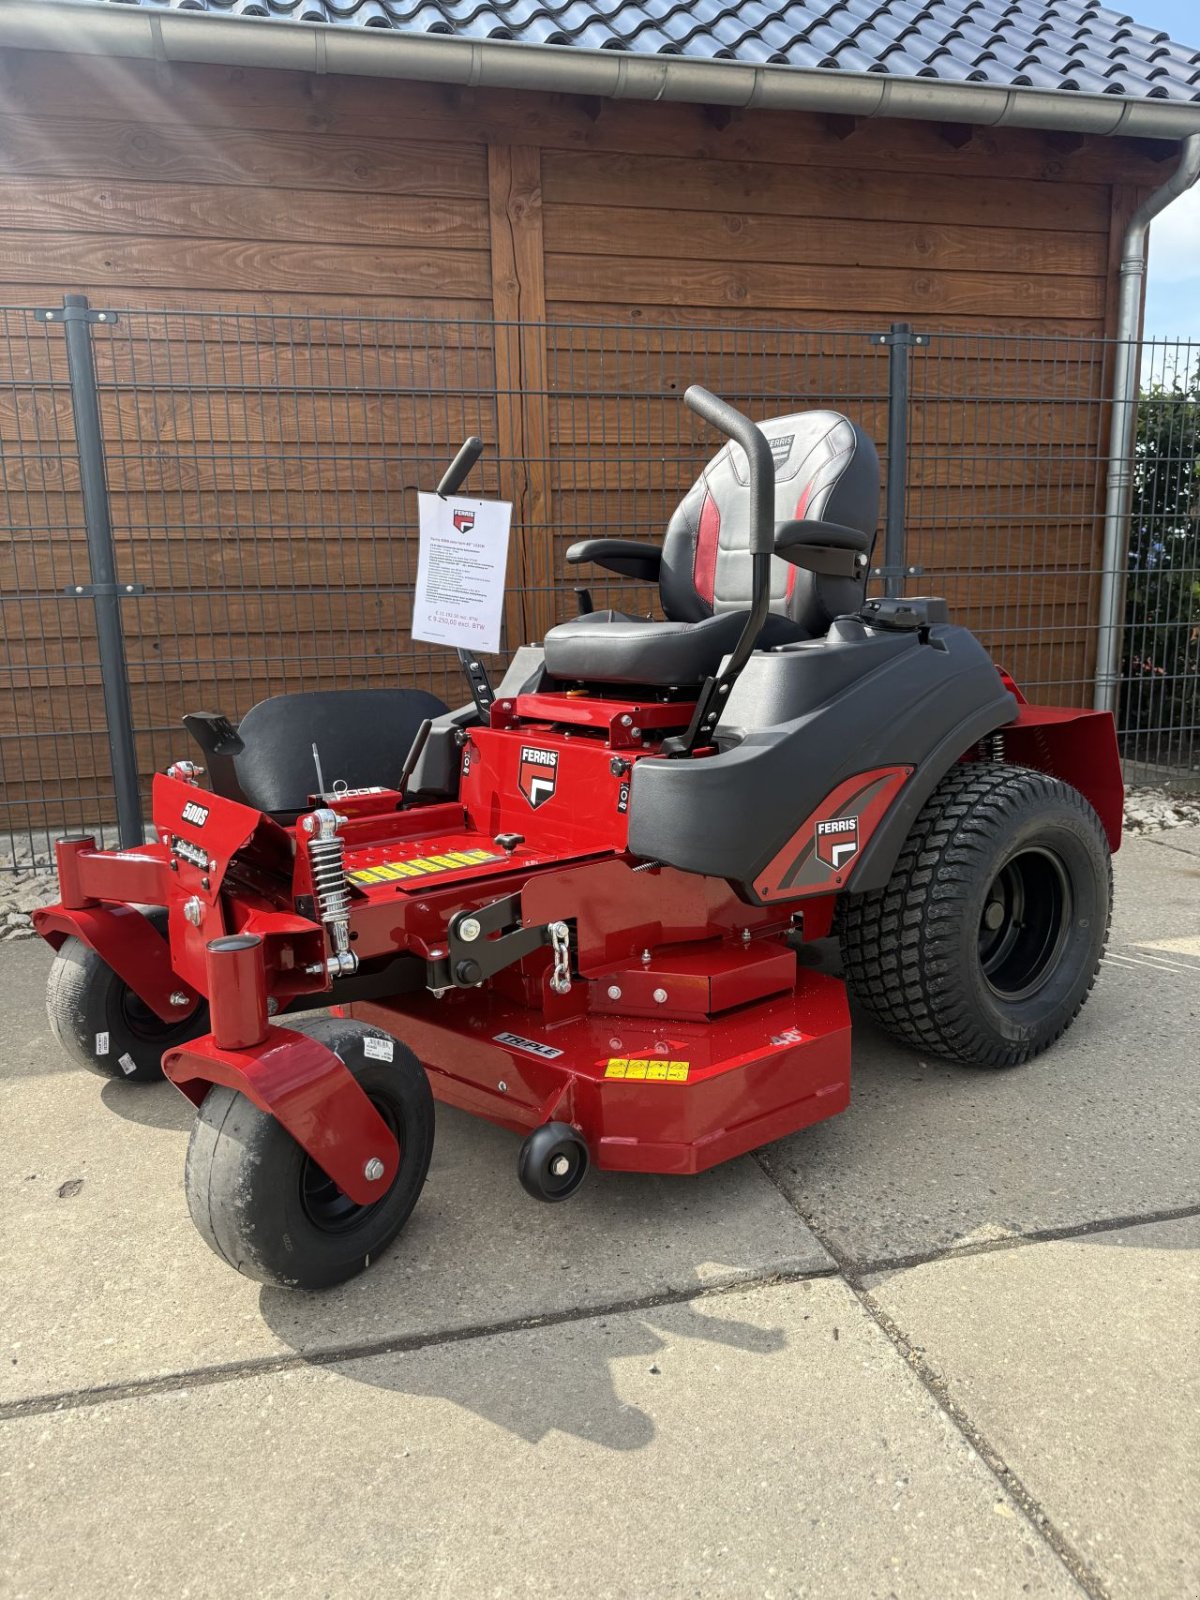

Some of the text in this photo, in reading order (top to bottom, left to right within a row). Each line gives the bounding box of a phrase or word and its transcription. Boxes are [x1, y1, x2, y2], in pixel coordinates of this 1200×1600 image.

[767, 436, 792, 448] ERRIS
[472, 622, 486, 631] BTW
[522, 748, 557, 766] FERRIS
[182, 802, 209, 825] 500S
[818, 819, 857, 835] FERRIS
[503, 1034, 559, 1056] TRIPLE
